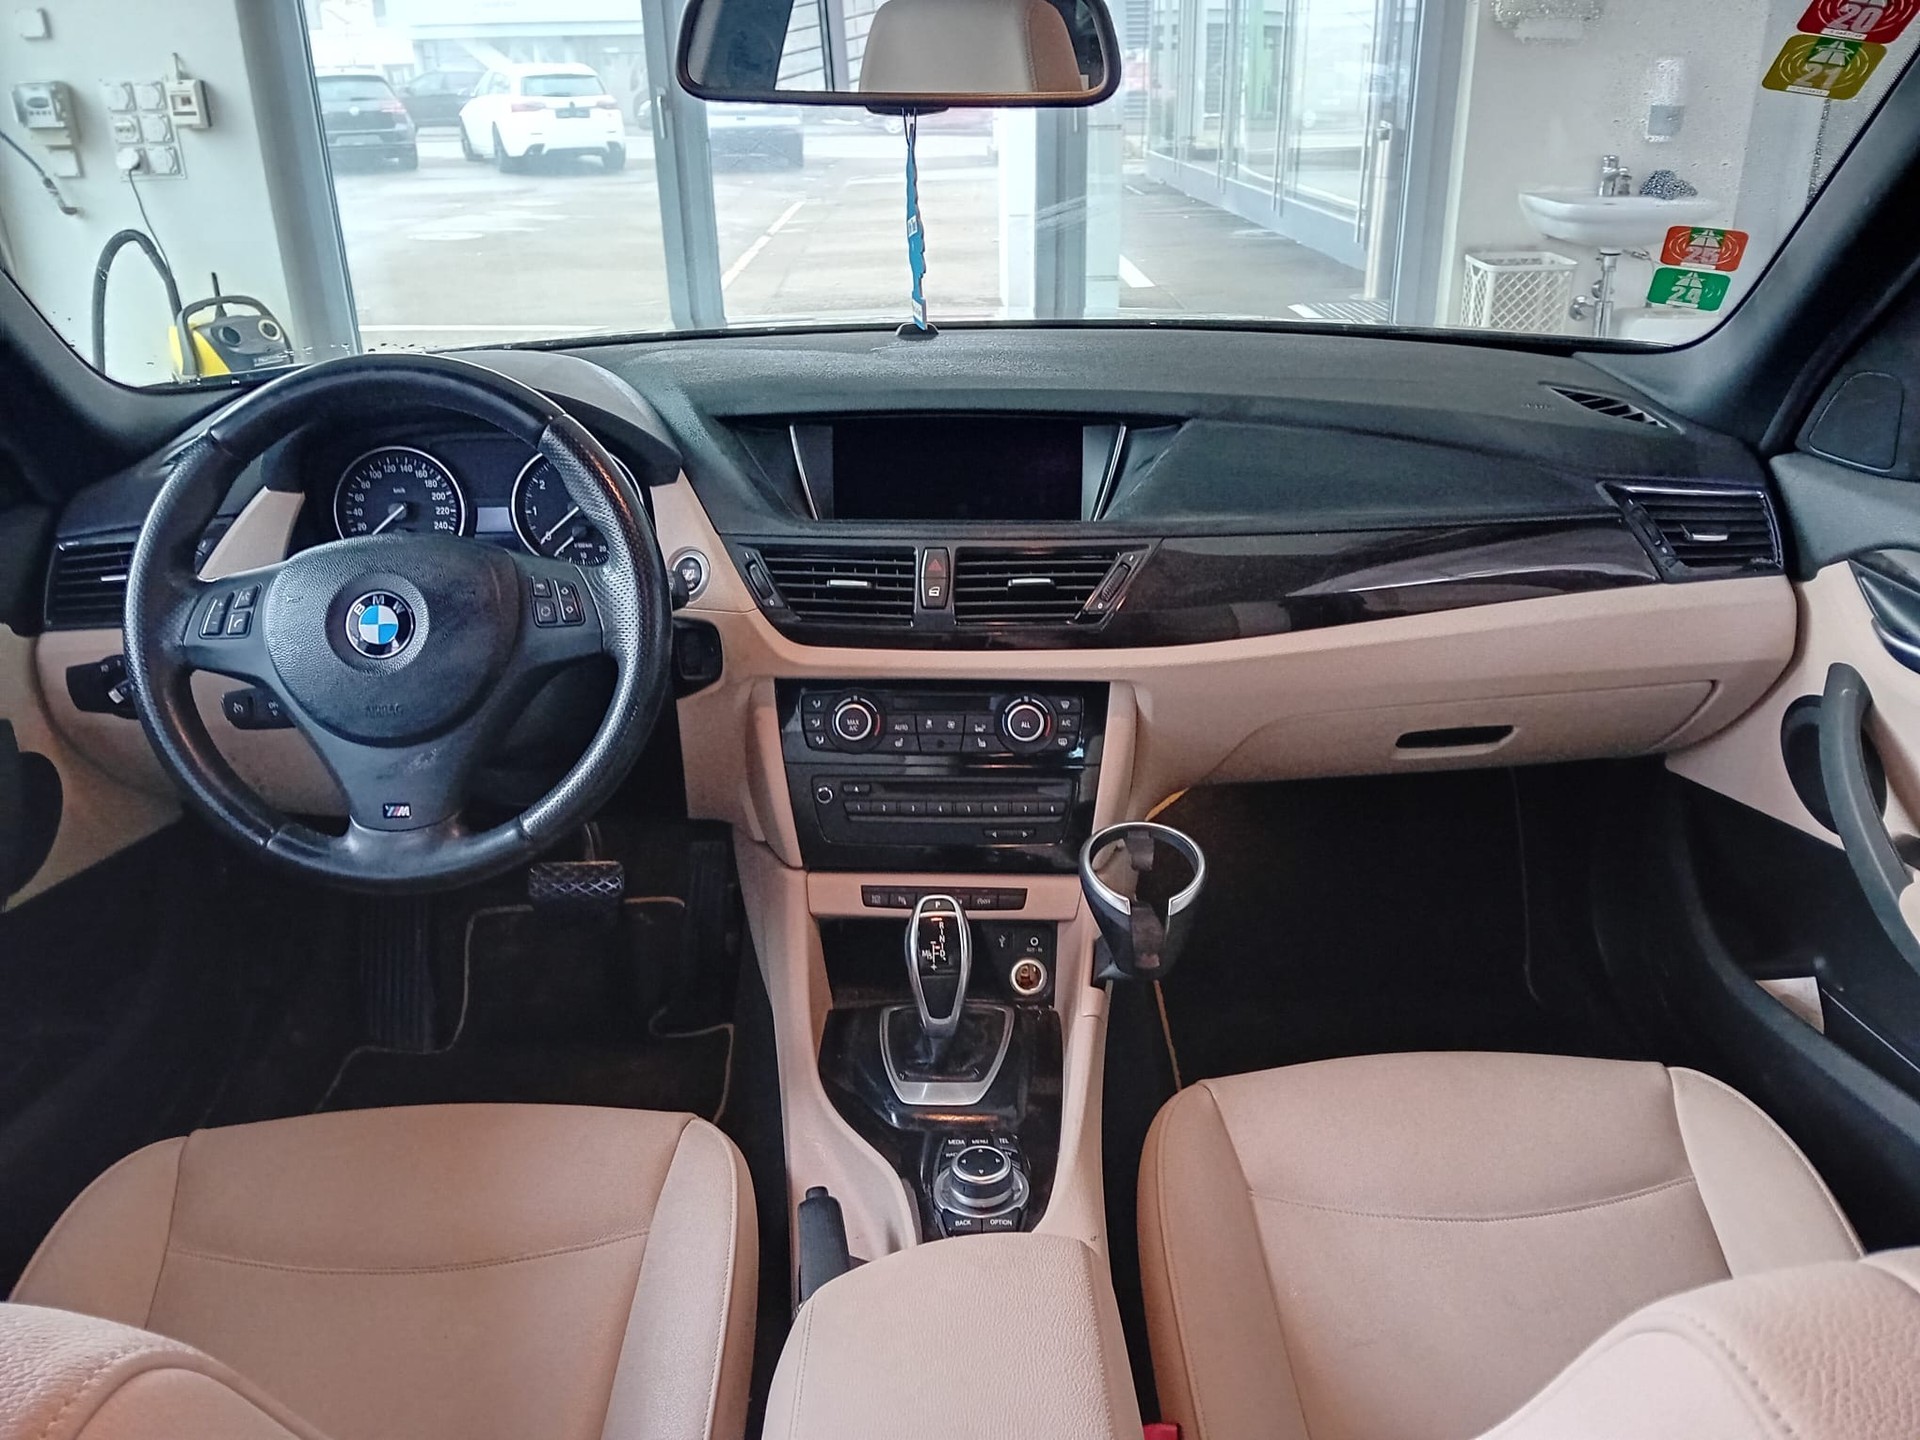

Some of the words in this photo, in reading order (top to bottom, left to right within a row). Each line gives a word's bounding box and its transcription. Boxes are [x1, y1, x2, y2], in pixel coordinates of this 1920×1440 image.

[1826, 3, 1883, 33] 20
[1793, 63, 1843, 90] 21
[1668, 286, 1702, 304] 24
[384, 465, 396, 473] 120
[401, 465, 413, 473] 140
[370, 471, 382, 479] 100
[415, 470, 428, 478] 160
[425, 480, 438, 488] 180
[540, 480, 546, 490] 2
[355, 494, 365, 502] 60
[432, 492, 446, 501] 200
[353, 508, 363, 516] 40
[436, 507, 450, 515] 220
[357, 522, 367, 531] 20
[434, 521, 448, 530] 240
[353, 594, 406, 616] BMW
[1021, 721, 1031, 729] ALL
[1061, 719, 1071, 727] A/C
[954, 1219, 972, 1227] BACK
[989, 1218, 1013, 1226] OPTION
